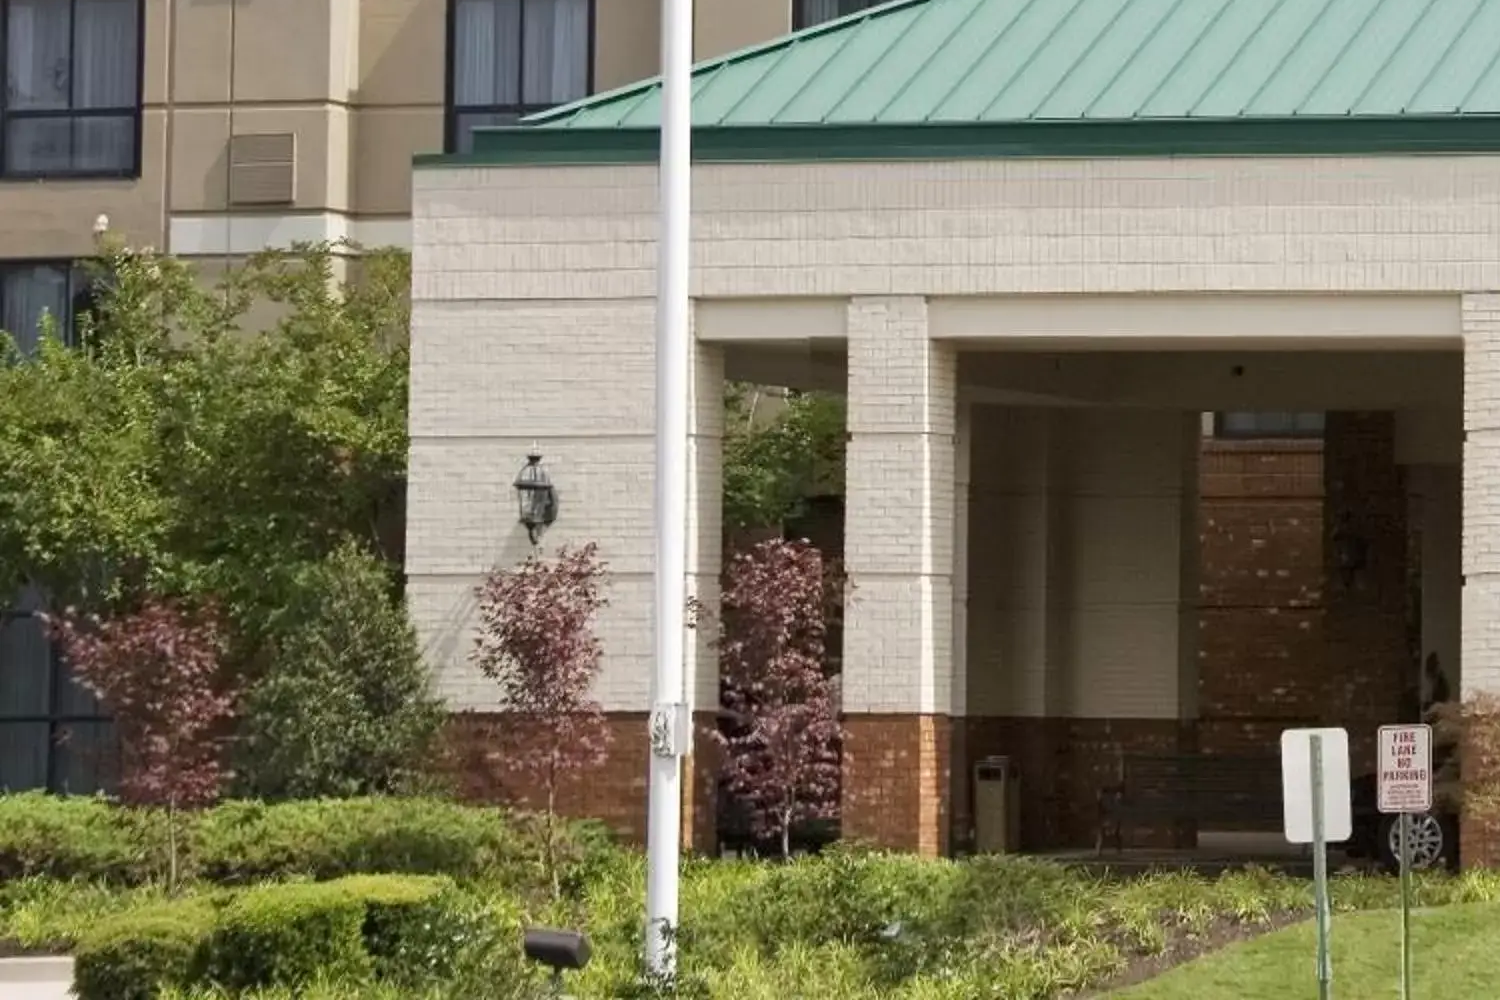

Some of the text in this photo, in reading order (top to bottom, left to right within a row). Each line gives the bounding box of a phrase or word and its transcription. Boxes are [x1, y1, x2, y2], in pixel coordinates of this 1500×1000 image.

[1393, 731, 1416, 742] FIRE
[1391, 745, 1416, 756] LANE
[1397, 758, 1412, 768] NO
[1383, 769, 1427, 781] PARKING
